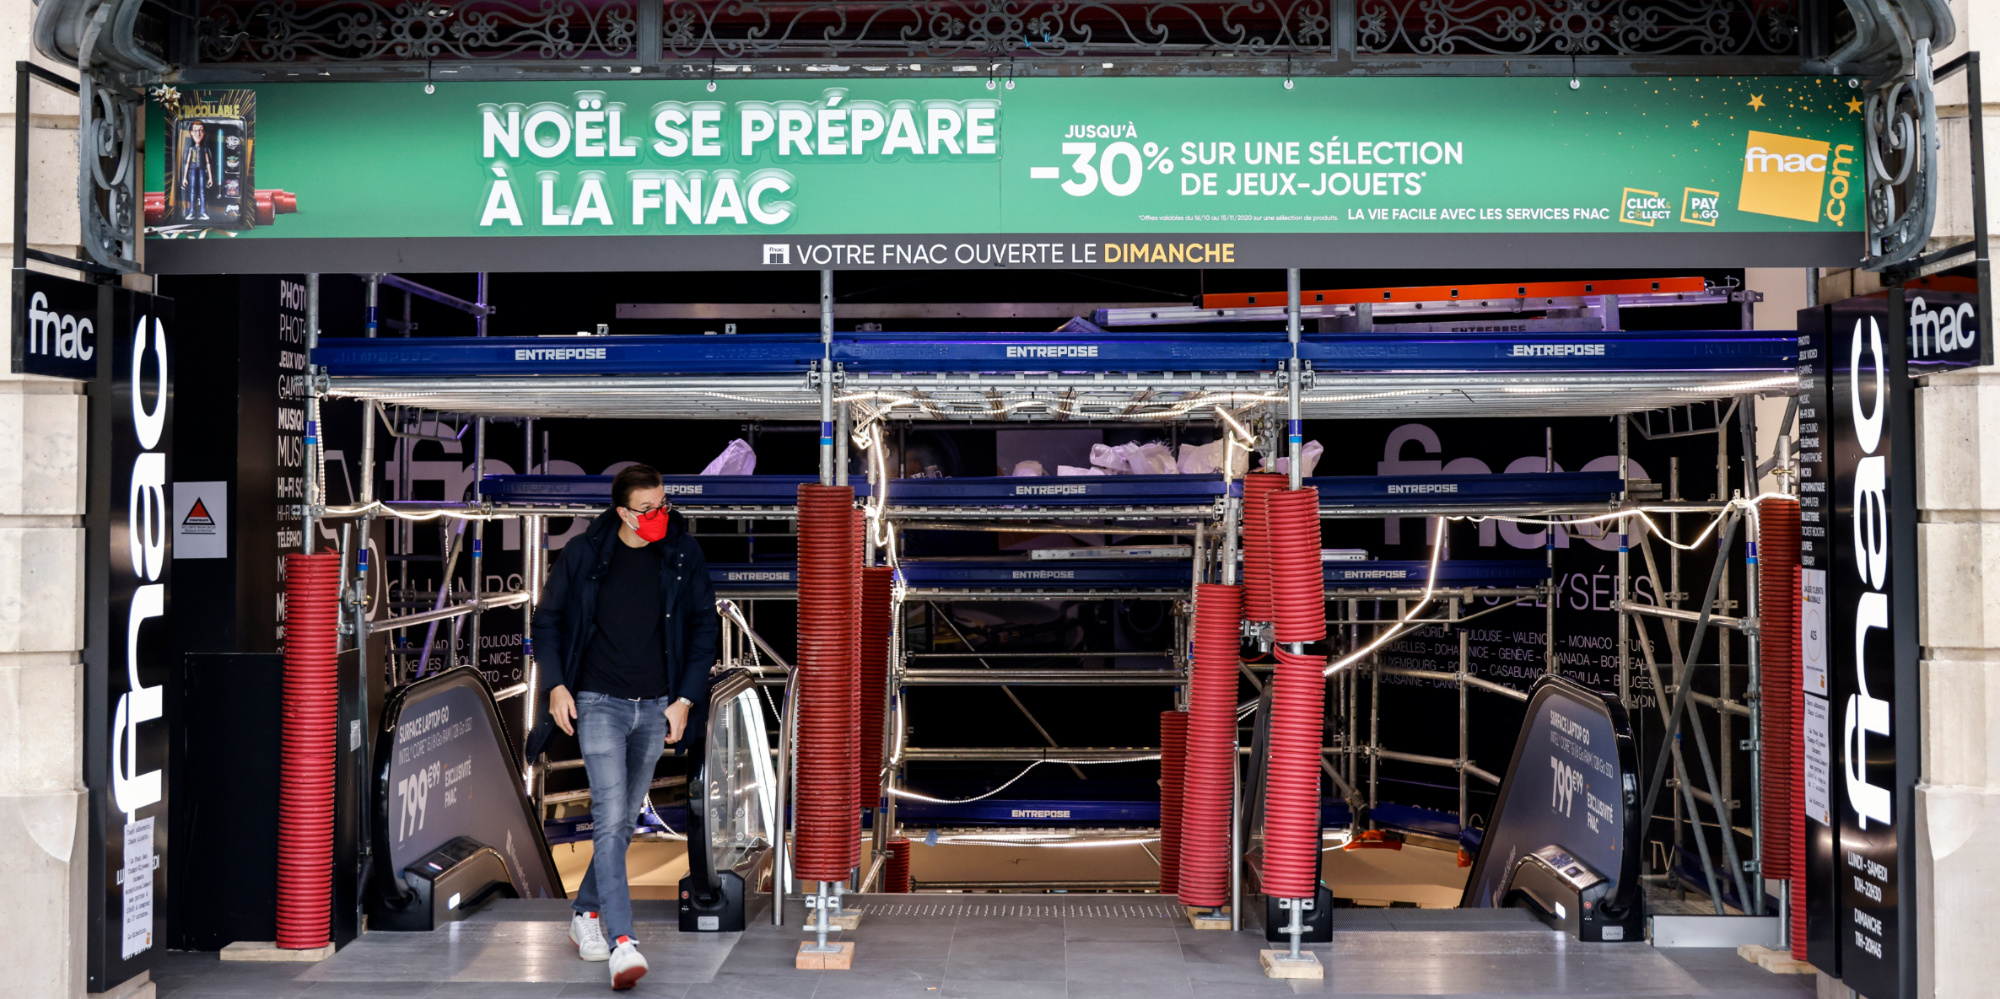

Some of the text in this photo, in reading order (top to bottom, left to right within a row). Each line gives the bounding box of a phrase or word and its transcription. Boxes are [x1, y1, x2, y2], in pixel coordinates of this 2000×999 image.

[483, 98, 997, 158] NOËL SE PRÉPARE
[1064, 122, 1138, 140] JUSQU'À
[1181, 135, 1463, 166] SUR UNE SÉLECTION
[1745, 146, 1828, 173] fnac
[1030, 141, 1174, 197] -30%
[1181, 172, 1217, 197] DE
[1826, 143, 1854, 227] .com
[480, 167, 791, 227] À LA FNAC
[1692, 198, 1719, 209] PAY
[1313, 214, 1339, 222] produits.
[1348, 208, 1610, 220] LA VIE FACILE AVEC LES SERVICES FNAC
[797, 243, 1235, 264] VOTRE FNAC OUVERTE LE DIMANCHE
[280, 279, 307, 311] PHOT
[29, 291, 94, 361] fnac
[280, 313, 306, 344] PHOT
[1910, 296, 1976, 359] fnac
[279, 350, 306, 371] JEUX VID
[515, 348, 607, 361] ENTREPOSE
[1006, 346, 1098, 358] ENTREPOSE
[1513, 344, 1605, 357] ENTREPOSE
[278, 407, 304, 431] MUSIQ
[278, 435, 304, 467] MUSI
[664, 485, 703, 495] EPOSE
[1016, 485, 1086, 495] ENTREPOSE
[1388, 484, 1458, 494] ENTREPOSE
[277, 526, 303, 549] TÉLÉPHO
[113, 314, 168, 825] fnac
[728, 572, 789, 581] ENTREPOSE
[1012, 570, 1075, 579] ENTREPOSE
[1344, 571, 1406, 579] ENTREPOSE
[1845, 315, 1891, 830] fnac
[1468, 646, 1489, 659] NICE
[1498, 646, 1534, 662] GENÈVE
[1568, 635, 1613, 650] MONACO
[489, 651, 512, 665] NICE
[399, 705, 449, 744] SURFACE LAPTOP GO
[1550, 709, 1590, 746] SURFACE LAPTOP GO
[445, 755, 472, 788] EXCLUSIVITÉ
[444, 787, 457, 808] FNAC
[1587, 791, 1614, 825] EXCLUSIVITÉ
[1011, 809, 1071, 818] ENTREPOSE
[1587, 811, 1599, 834] FNAC
[1847, 850, 1888, 883] LUNDI SAMEDI
[1854, 907, 1882, 937] DIMANCHE
